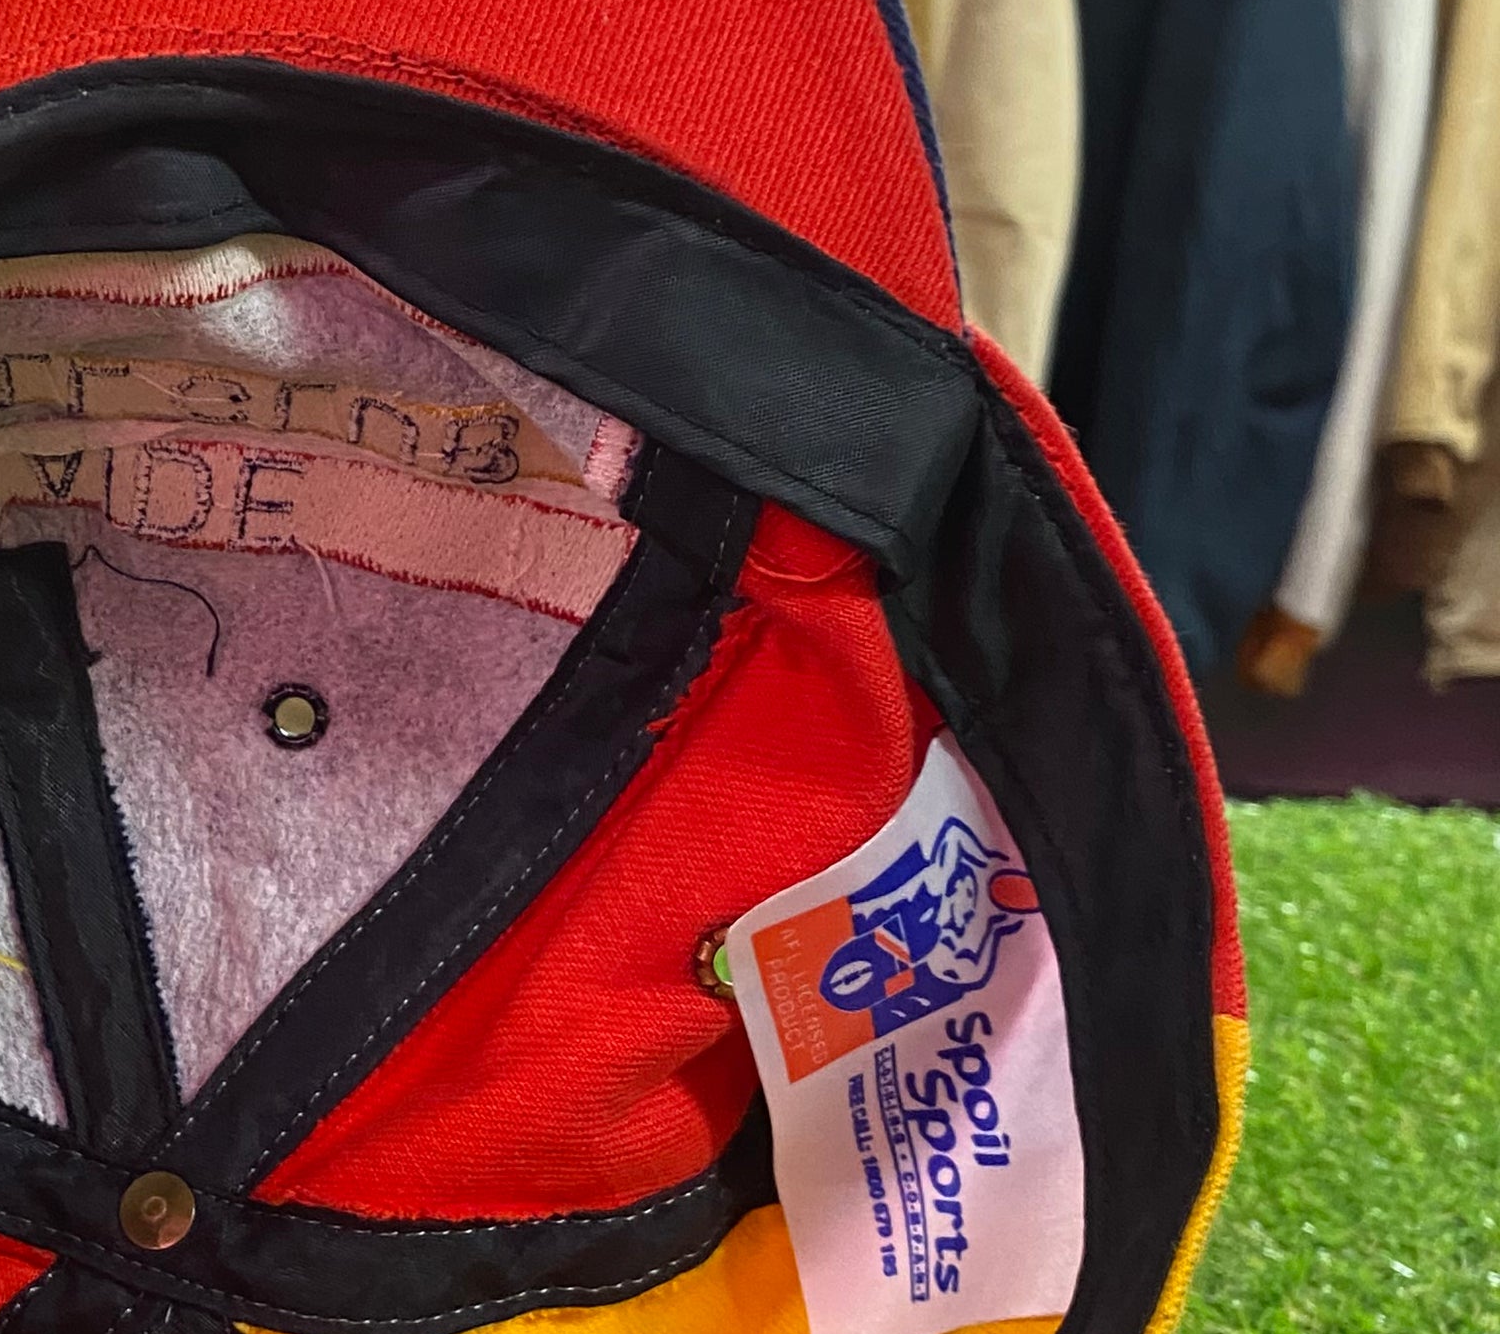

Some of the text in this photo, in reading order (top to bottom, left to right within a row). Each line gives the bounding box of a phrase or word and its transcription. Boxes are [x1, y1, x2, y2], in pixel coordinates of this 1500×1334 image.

[780, 928, 802, 963] AFL
[765, 958, 806, 1051] PRODUCT
[902, 1068, 969, 1293] Sports
